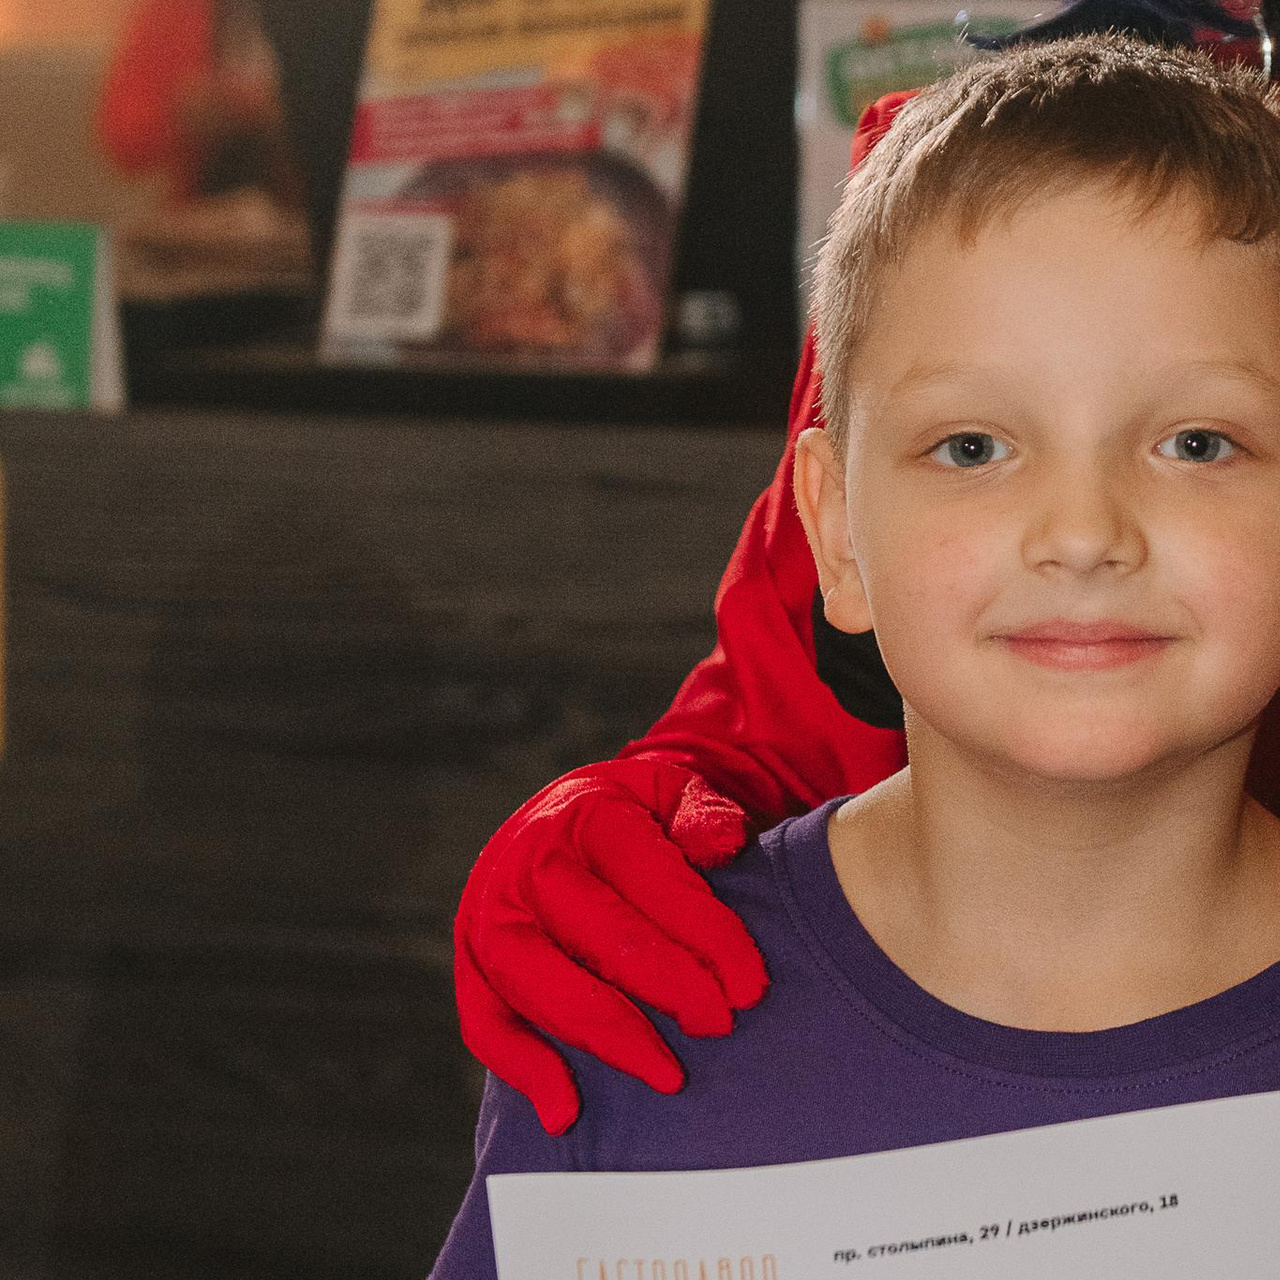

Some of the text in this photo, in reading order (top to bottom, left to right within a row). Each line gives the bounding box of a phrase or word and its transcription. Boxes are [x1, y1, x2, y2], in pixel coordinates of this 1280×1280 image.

[834, 1249, 861, 1264] пр.
[867, 1232, 974, 1258] столыпина,
[980, 1223, 1000, 1240] 29
[1018, 1201, 1155, 1236] дзержинского,
[1160, 1193, 1179, 1209] 18
